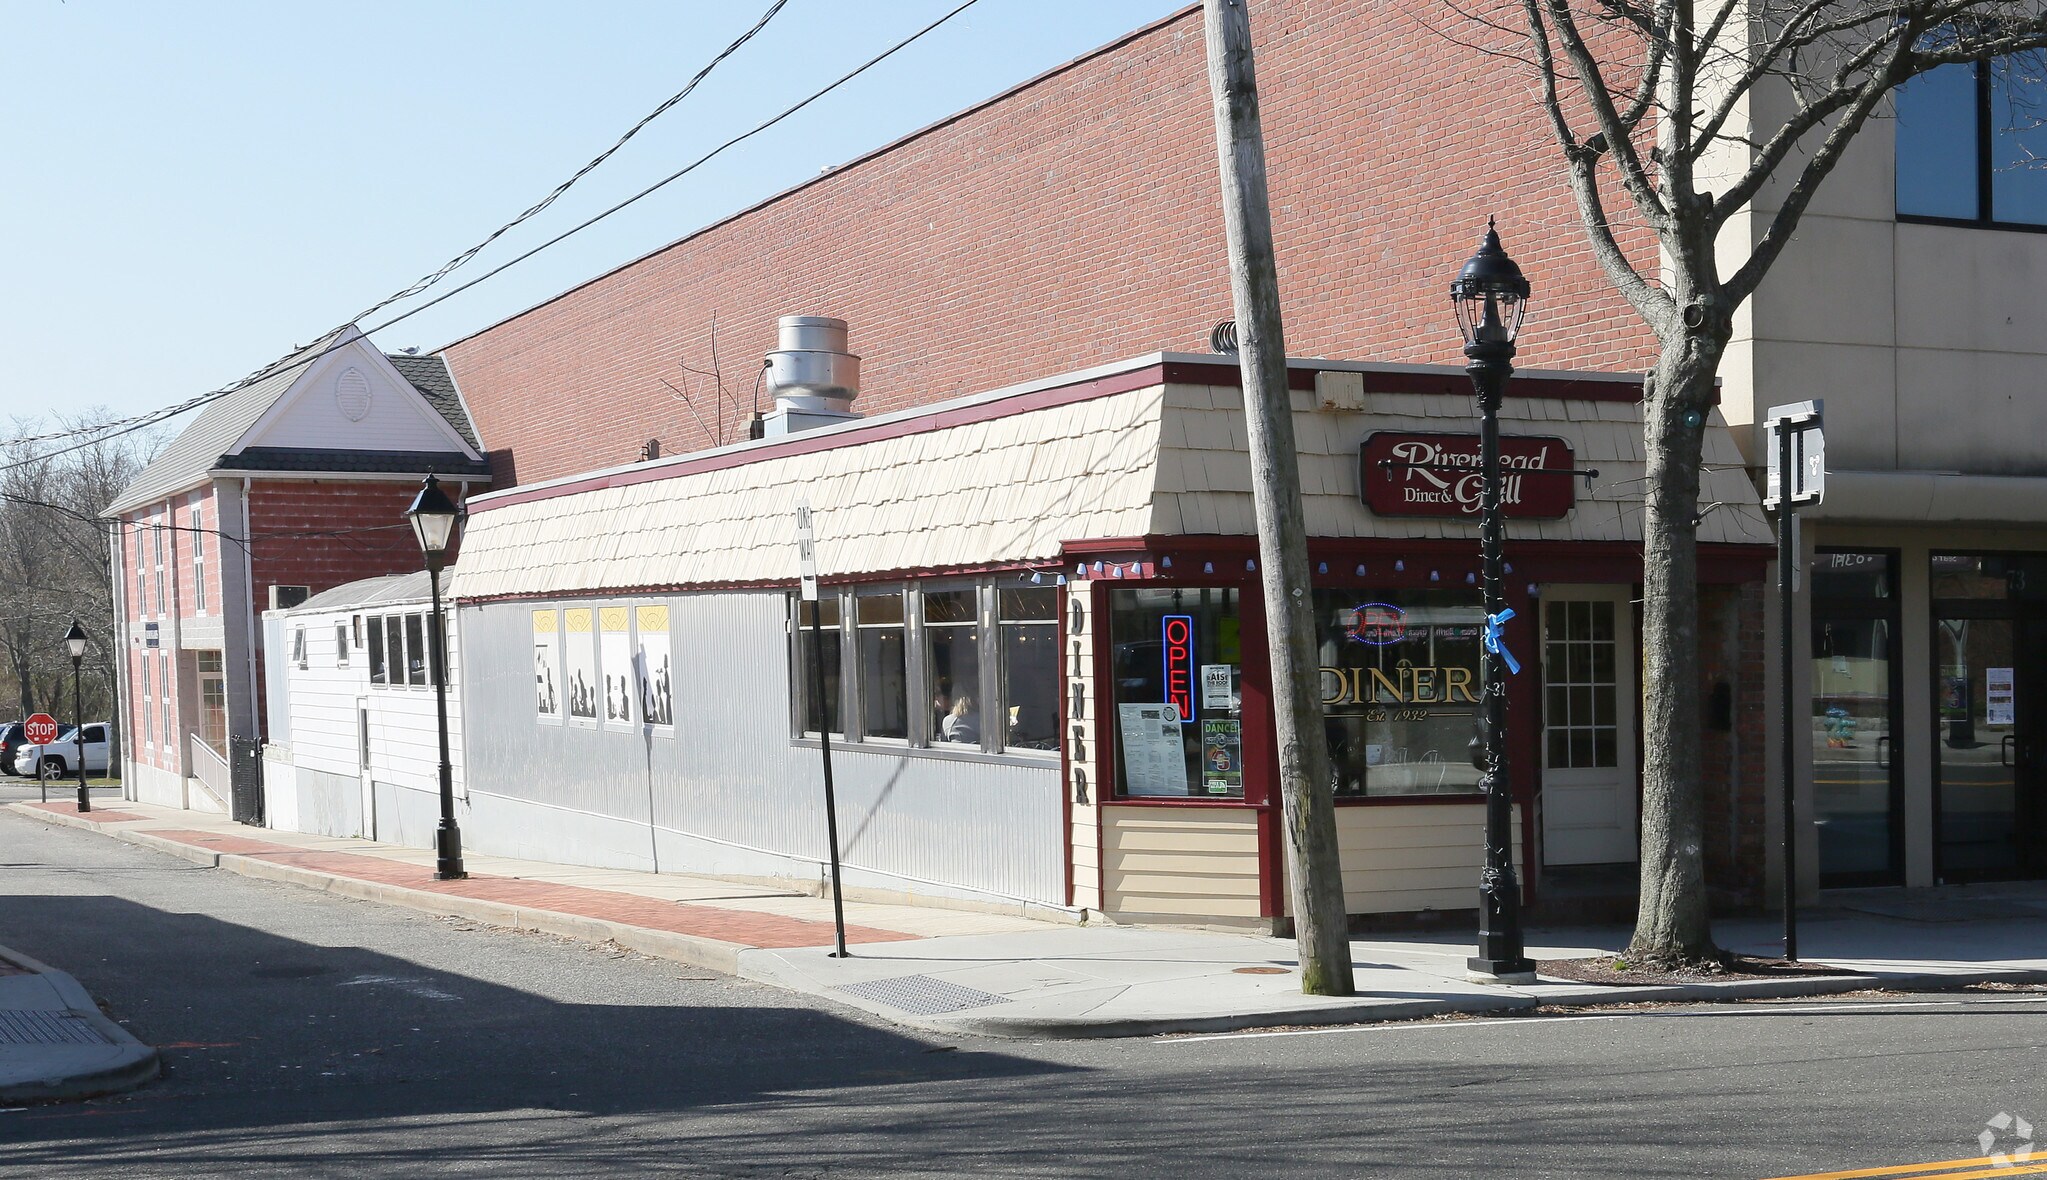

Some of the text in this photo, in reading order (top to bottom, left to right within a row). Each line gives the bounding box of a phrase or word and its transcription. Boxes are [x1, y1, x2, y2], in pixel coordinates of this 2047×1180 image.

[1392, 441, 1548, 489] Riveread
[1455, 473, 1522, 513] Gill
[797, 506, 811, 529] ONE
[1296, 599, 1303, 608] 9
[1347, 612, 1408, 636] OPEN
[1167, 620, 1188, 718] OPEN
[1319, 667, 1481, 703] DINER
[1071, 598, 1090, 806] DINER
[1366, 708, 1429, 722] Est. 1932
[27, 723, 55, 736] STOP
